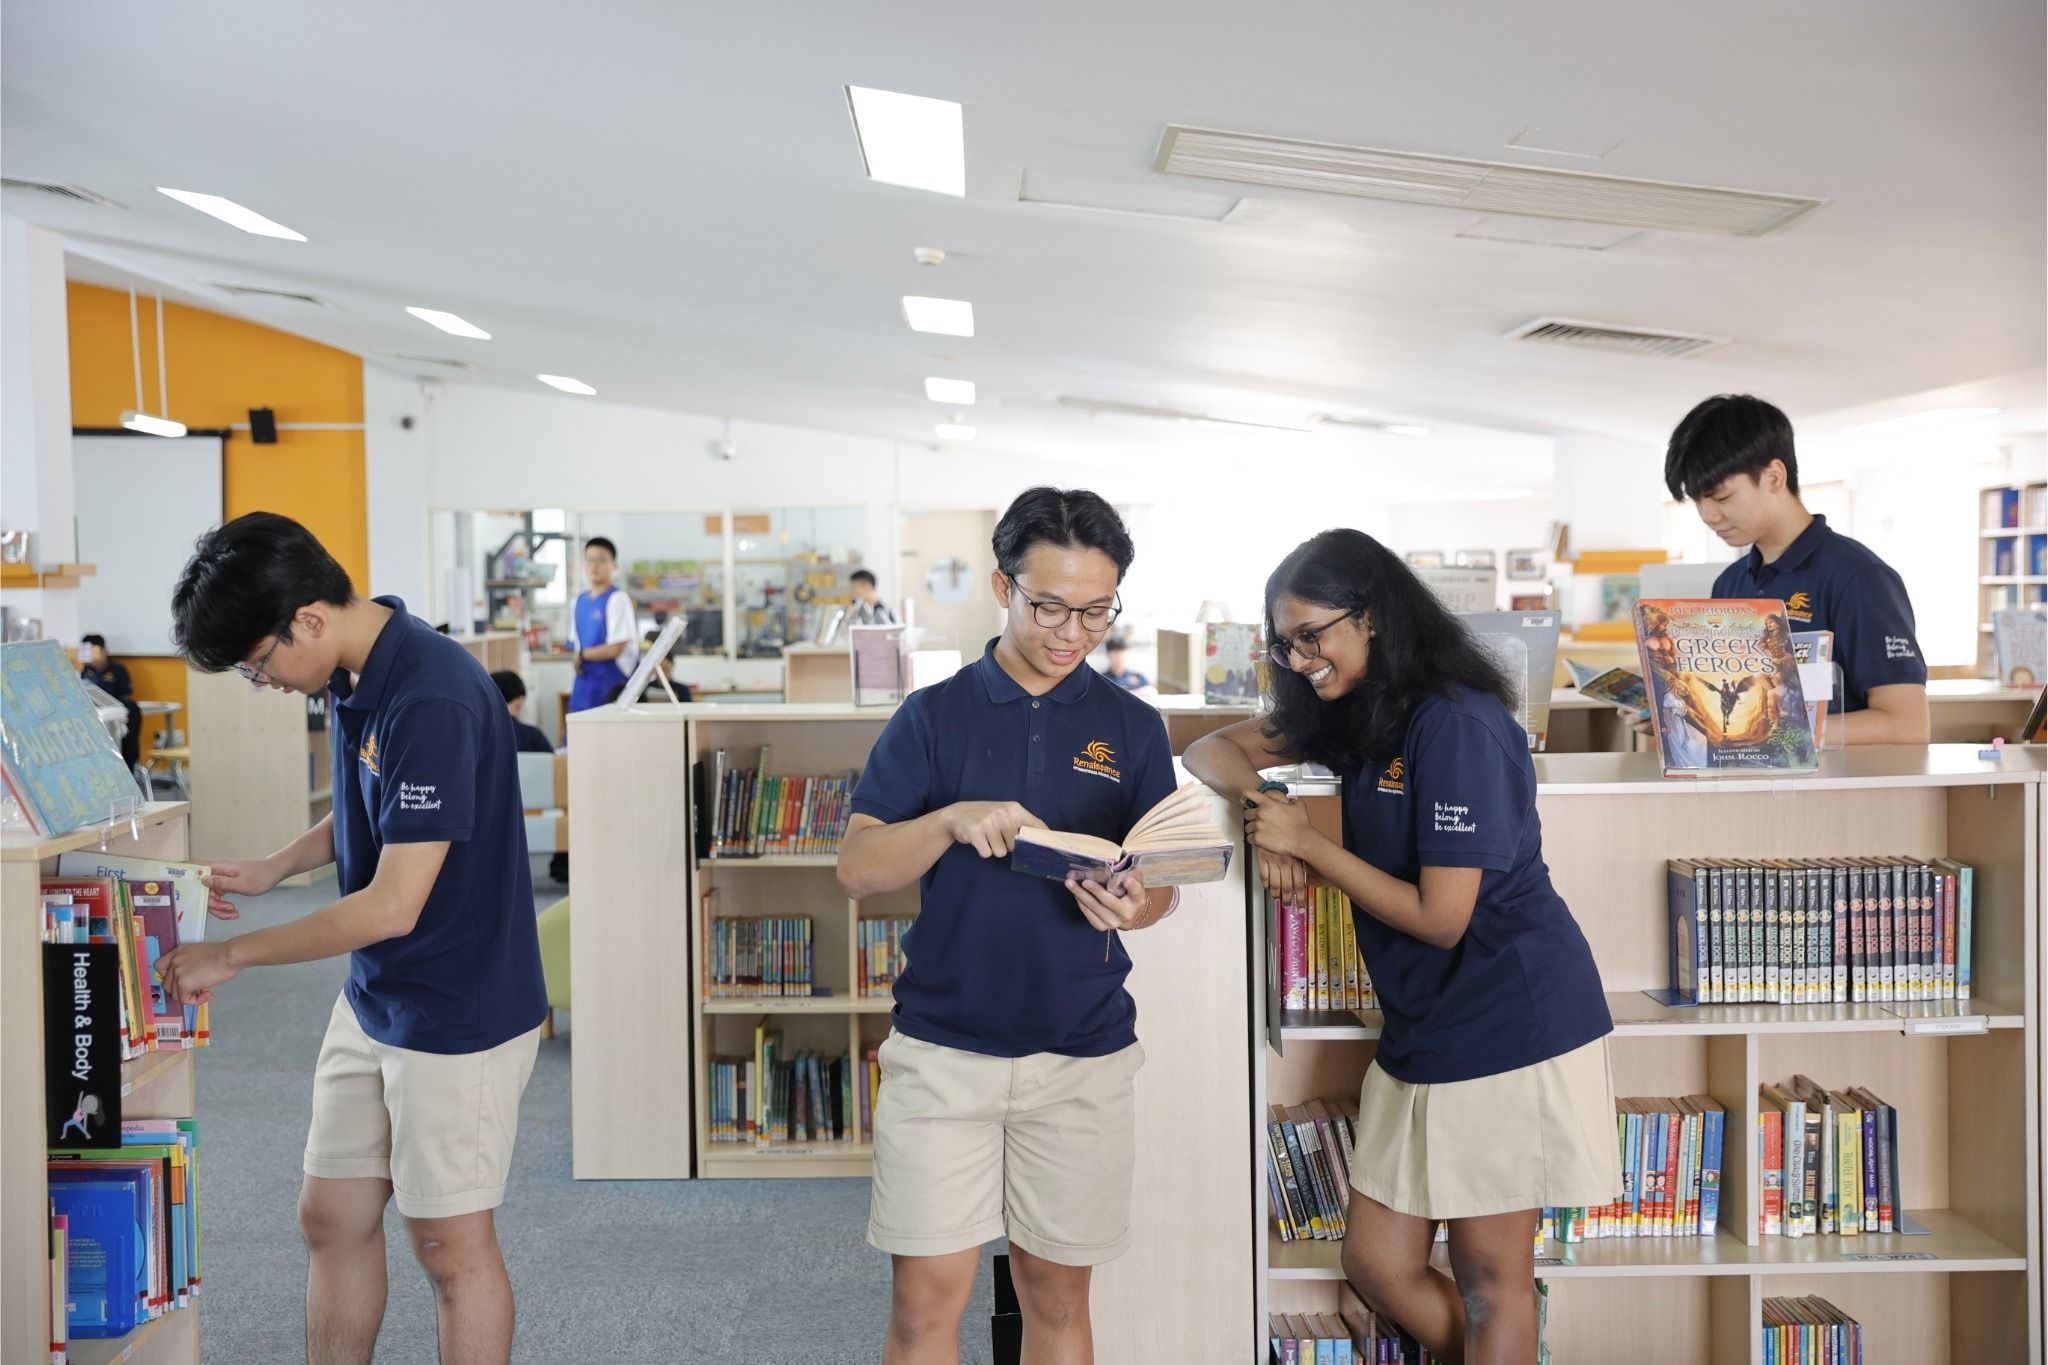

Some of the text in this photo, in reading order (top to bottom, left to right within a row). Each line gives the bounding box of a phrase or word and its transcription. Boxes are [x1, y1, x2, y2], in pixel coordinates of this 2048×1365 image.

[1676, 638, 1766, 656] GREEK
[1676, 656, 1776, 675] HEROES
[308, 697, 325, 715] M
[17, 717, 99, 768] WATER
[1073, 757, 1120, 778] Renaissance
[401, 782, 436, 793] Be happy
[401, 792, 427, 803] Belong
[401, 800, 442, 811] Be excellent
[1434, 802, 1469, 815] Be happy
[1434, 812, 1460, 825] Belong
[1434, 822, 1477, 833] Be excellent
[97, 865, 126, 880] First
[71, 953, 93, 1080] Health & Body
[121, 1124, 144, 1133] opedia
